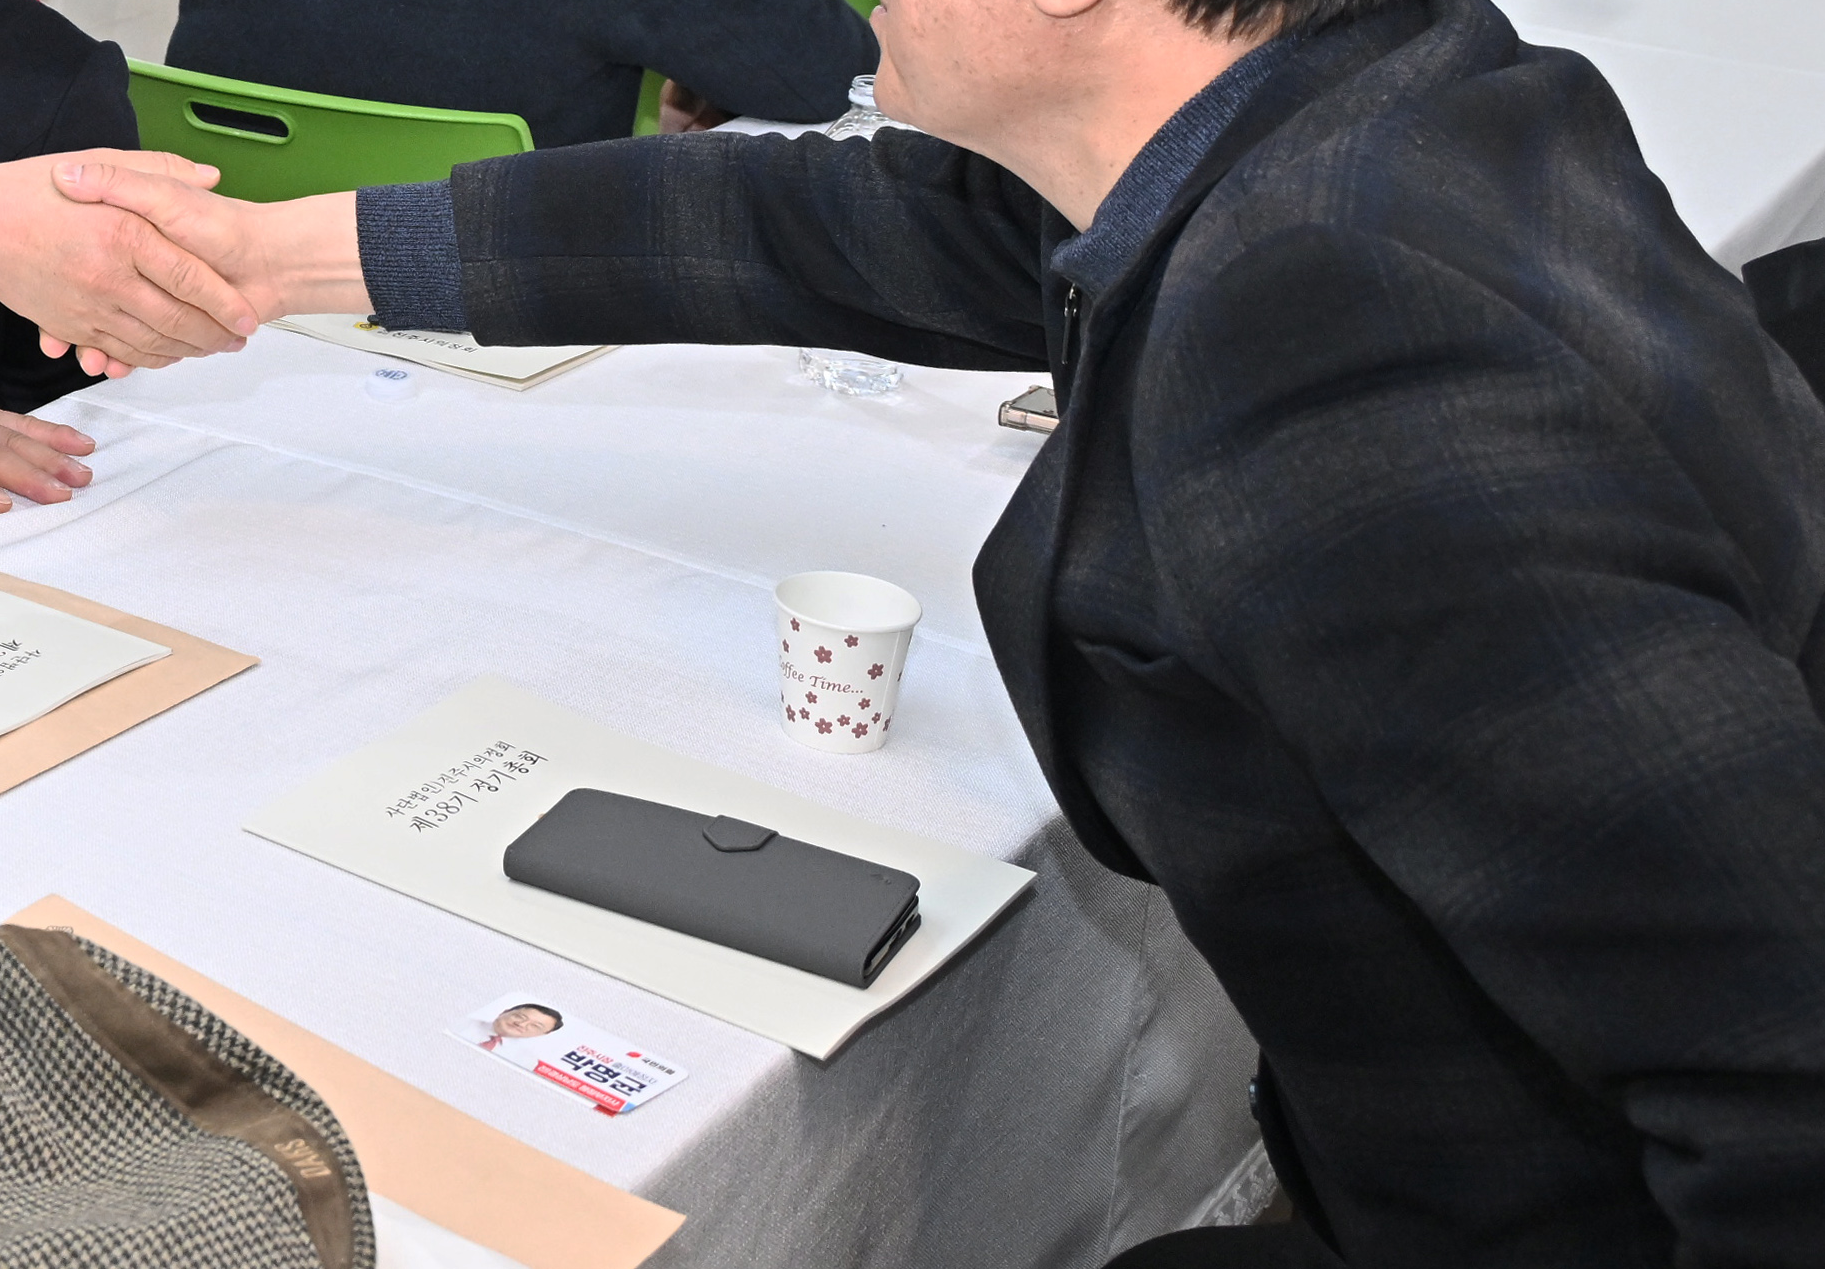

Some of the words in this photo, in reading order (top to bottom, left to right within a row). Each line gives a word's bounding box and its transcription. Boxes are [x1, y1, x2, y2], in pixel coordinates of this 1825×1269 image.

[809, 675, 864, 694] Time...
[386, 740, 516, 818] 사단법인)진주시의정회
[409, 791, 479, 833] 제38기
[470, 750, 549, 793] 정기총회
[560, 1050, 647, 1097] 박명균
